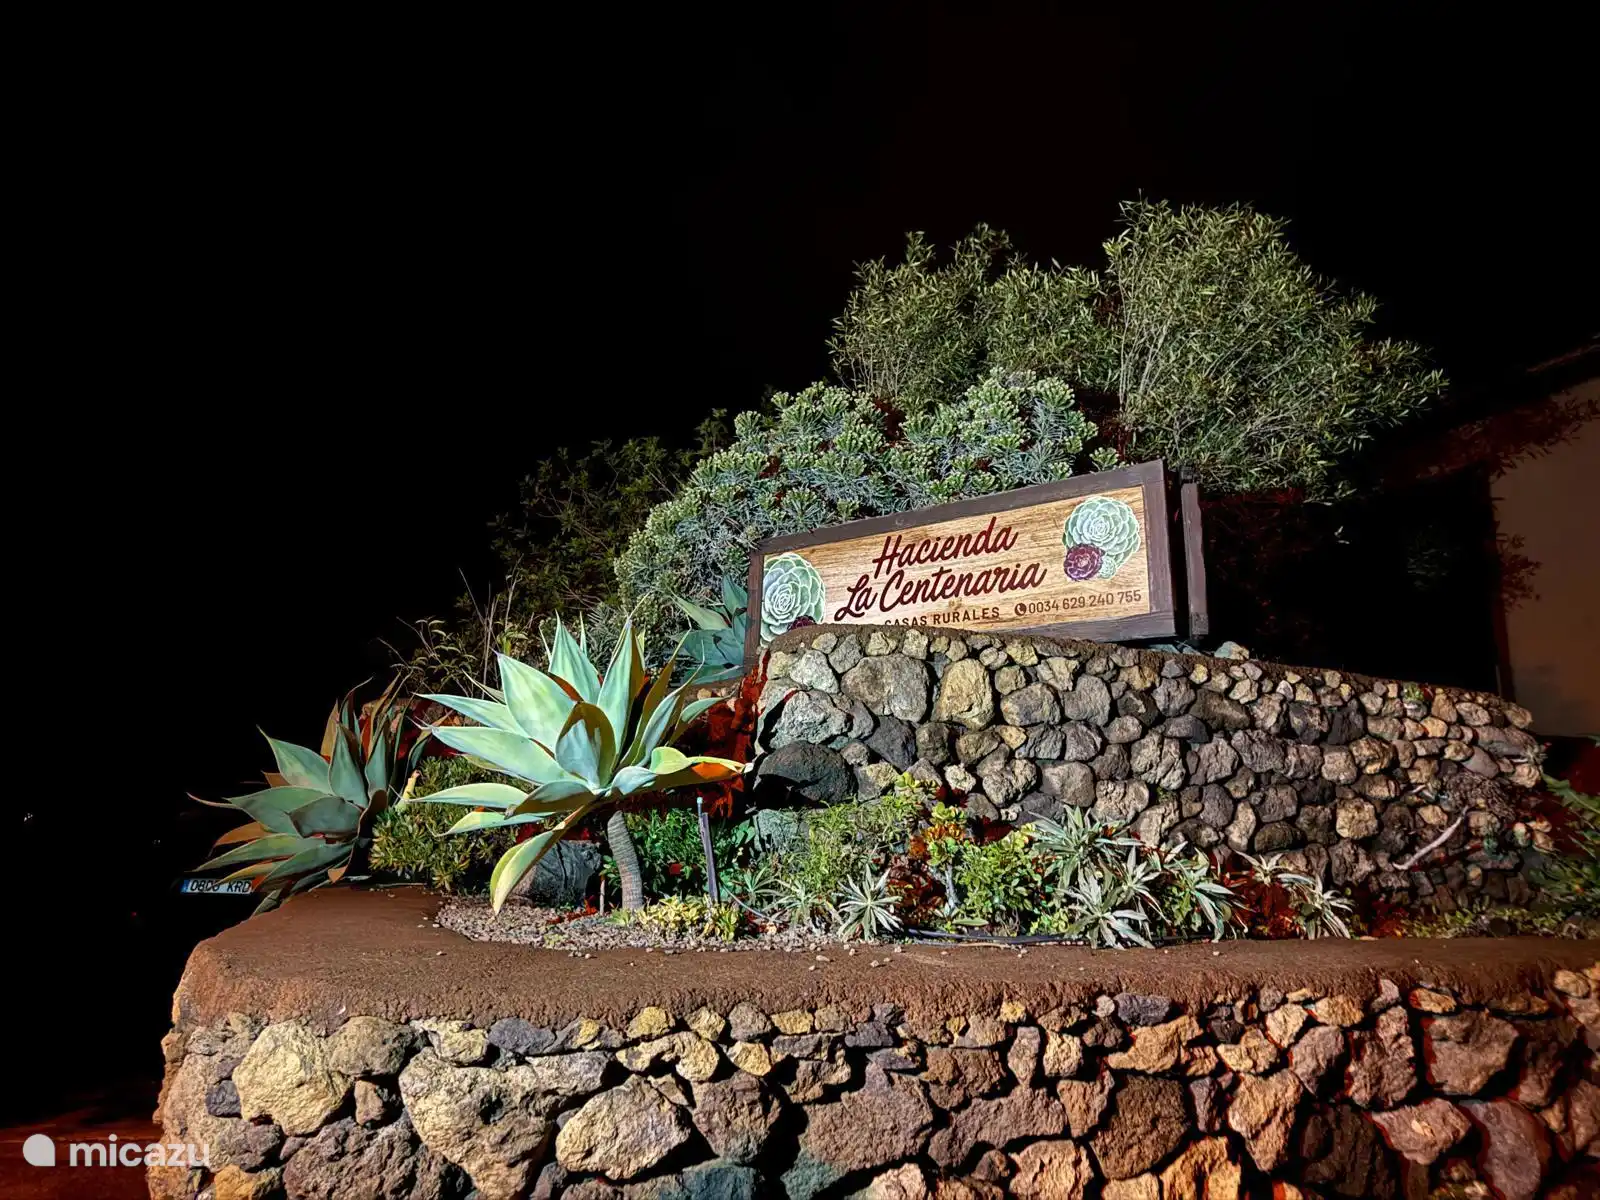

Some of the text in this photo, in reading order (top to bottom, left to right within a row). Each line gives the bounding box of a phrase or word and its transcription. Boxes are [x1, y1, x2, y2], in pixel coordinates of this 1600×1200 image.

[872, 516, 1019, 580] Hacienda
[834, 562, 1048, 622] La Centenaria
[1028, 589, 1142, 614] 0034 629 240 755
[933, 607, 1000, 625] RURALES
